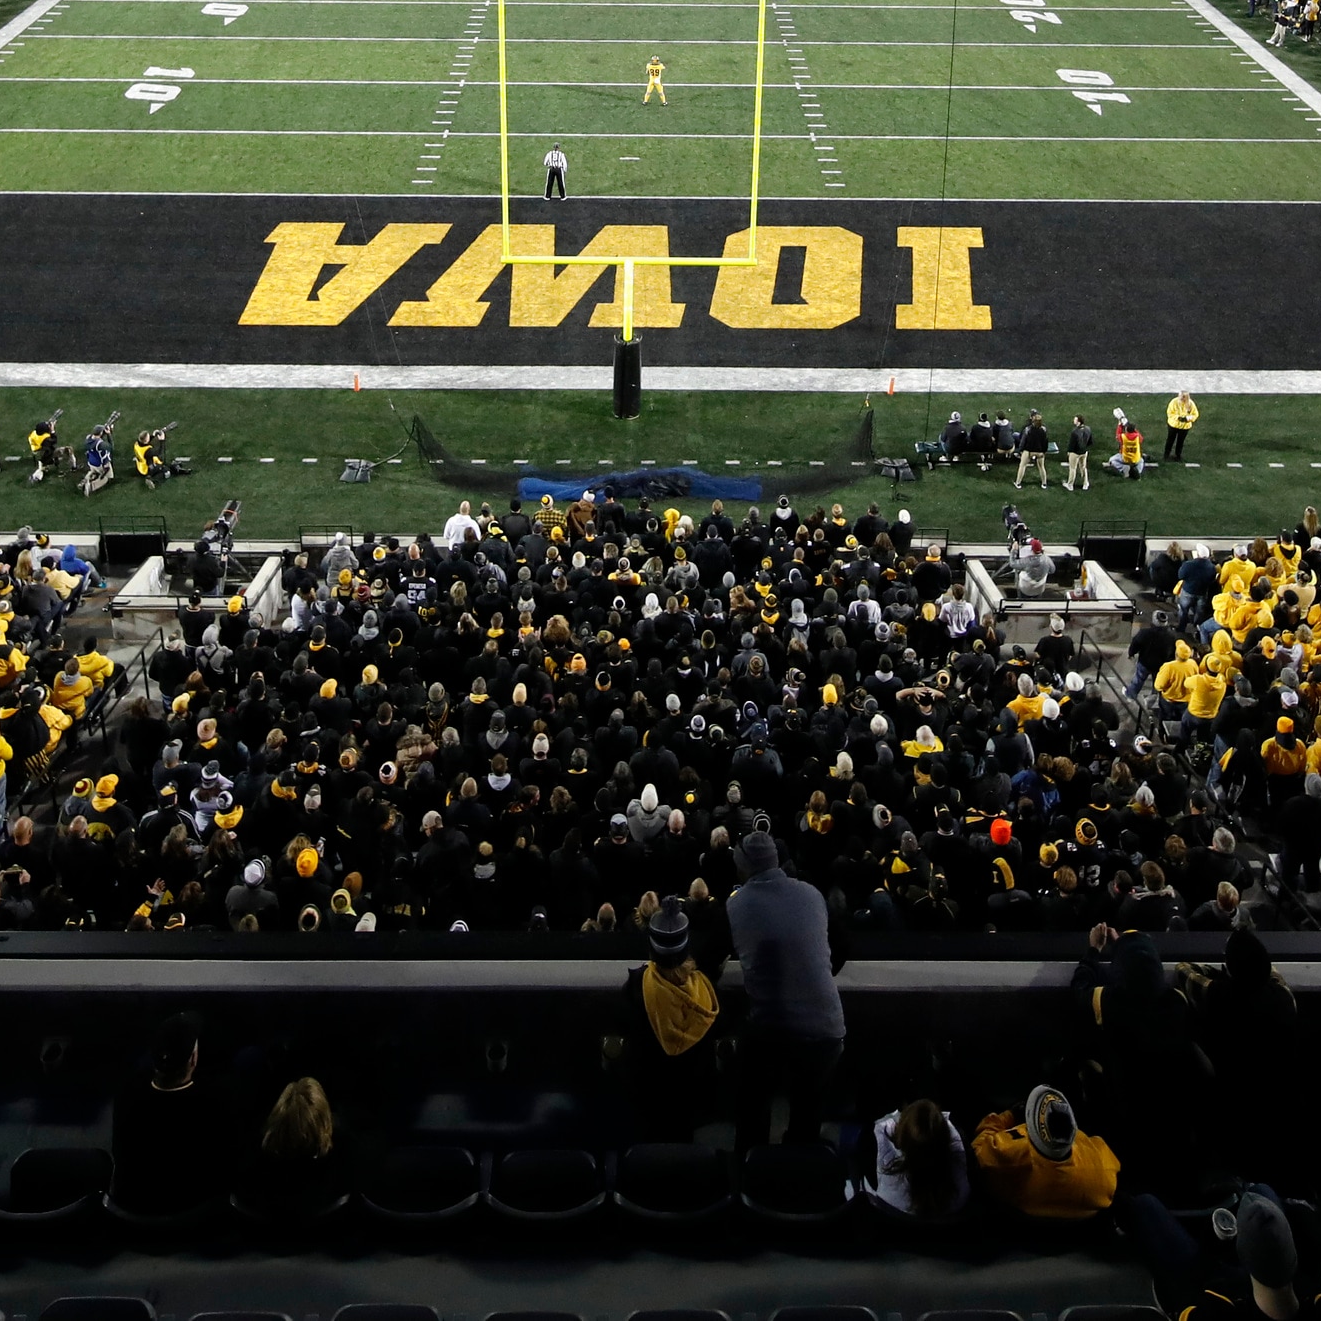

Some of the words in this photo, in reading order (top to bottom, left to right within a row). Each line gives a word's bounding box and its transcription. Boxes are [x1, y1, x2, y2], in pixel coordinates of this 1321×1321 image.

[124, 66, 196, 102] 10
[1055, 68, 1132, 103] 10
[238, 221, 992, 331] IOWA
